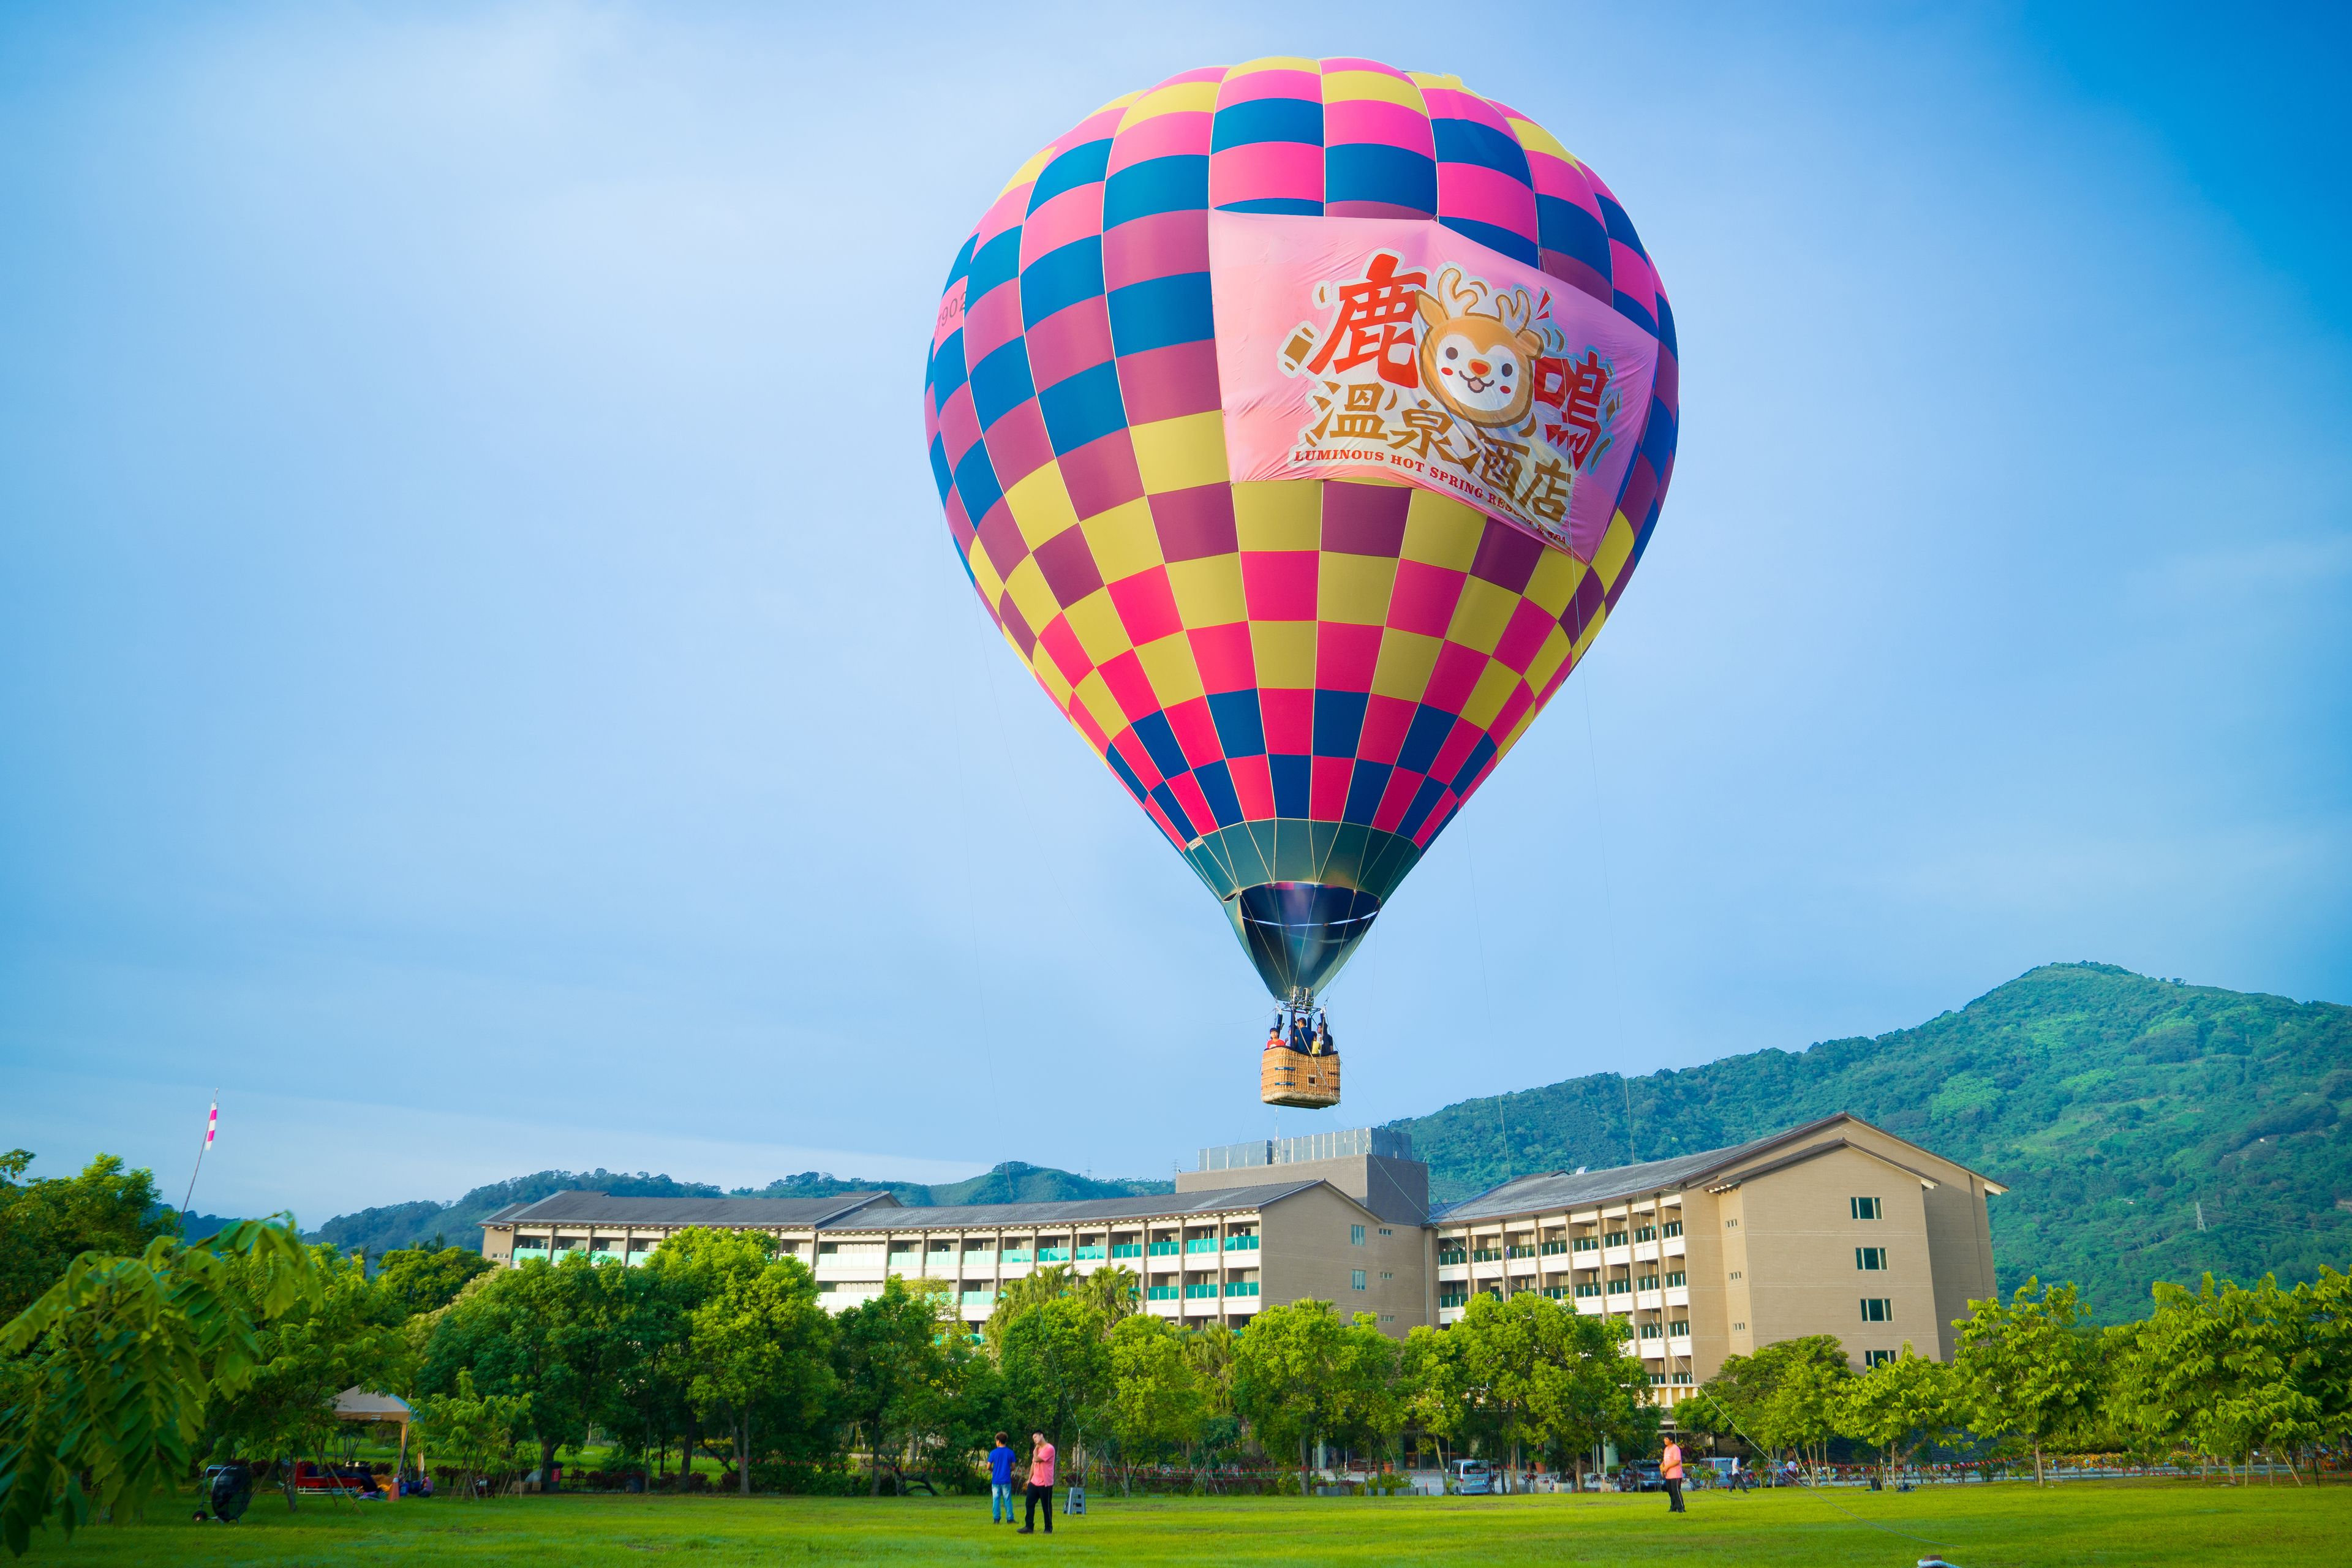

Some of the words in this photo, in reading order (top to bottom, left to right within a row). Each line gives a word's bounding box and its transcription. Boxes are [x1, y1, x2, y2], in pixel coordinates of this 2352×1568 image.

[1306, 253, 1427, 388] 鹿
[1294, 449, 1384, 461] LUMINOUS
[1390, 454, 1425, 472] HOT
[1430, 467, 1483, 499] SPRING
[1487, 492, 1534, 525] RES
